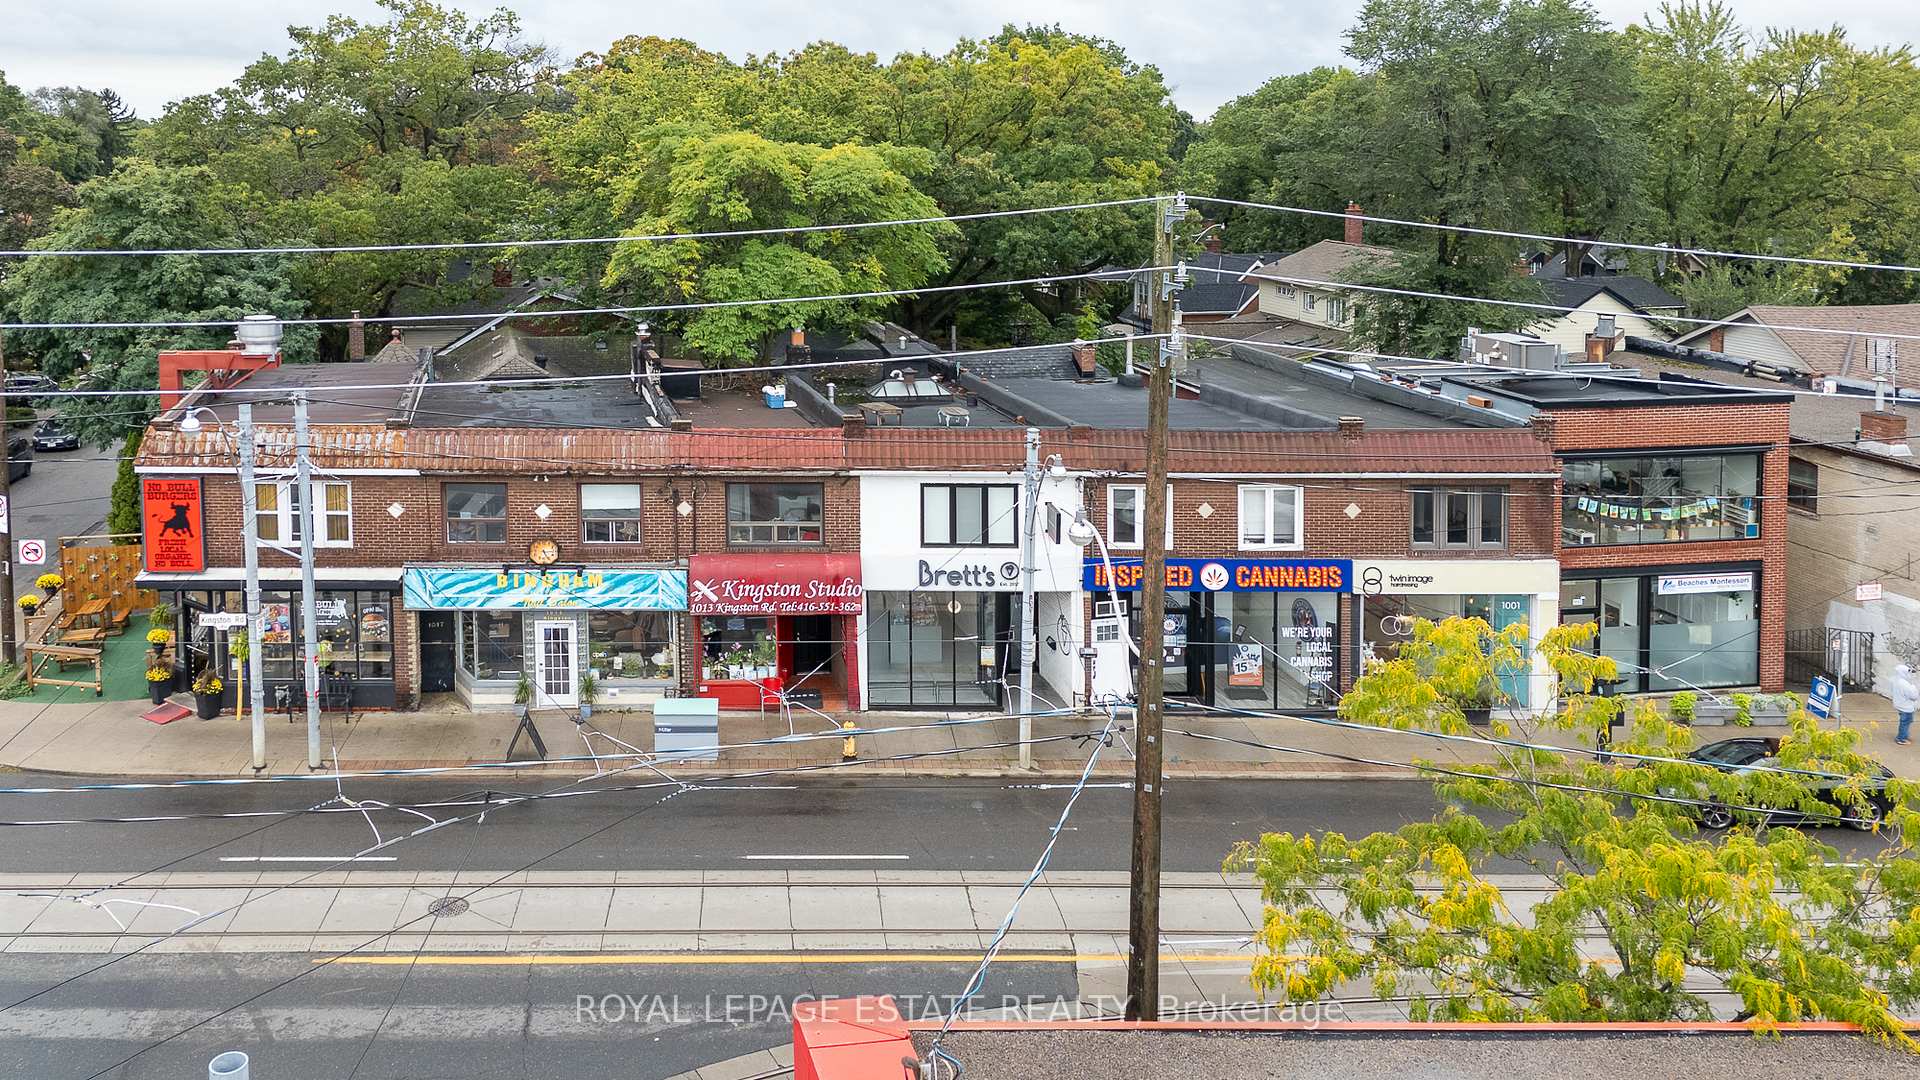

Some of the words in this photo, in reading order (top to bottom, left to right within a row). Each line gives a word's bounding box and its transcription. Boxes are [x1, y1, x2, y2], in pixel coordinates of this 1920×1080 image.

[147, 483, 161, 491] NO
[167, 483, 195, 491] BULL
[147, 492, 197, 500] BURGERS
[918, 559, 995, 587] Brett's
[1094, 563, 1194, 587] INSPED
[1235, 565, 1343, 588] CANNABIS
[496, 573, 603, 588] BINGHAM
[1389, 574, 1407, 582] twin
[1407, 574, 1434, 584] image
[1677, 579, 1708, 587] Beaches
[721, 579, 802, 603] Kingston
[804, 577, 862, 598] Studio
[690, 603, 714, 613] 1013
[716, 602, 759, 615] Kingston
[779, 602, 862, 613] Tel:416-551-362
[1501, 601, 1520, 610] 1001
[201, 615, 231, 624] Kingston
[235, 616, 244, 624] Rd
[1281, 627, 1309, 638] WE'RE
[1310, 627, 1333, 638] YOUR
[1306, 642, 1333, 653] LOCAL
[1290, 656, 1333, 667] CANNABIS
[1235, 662, 1248, 673] 15
[1309, 671, 1333, 682] SHOP
